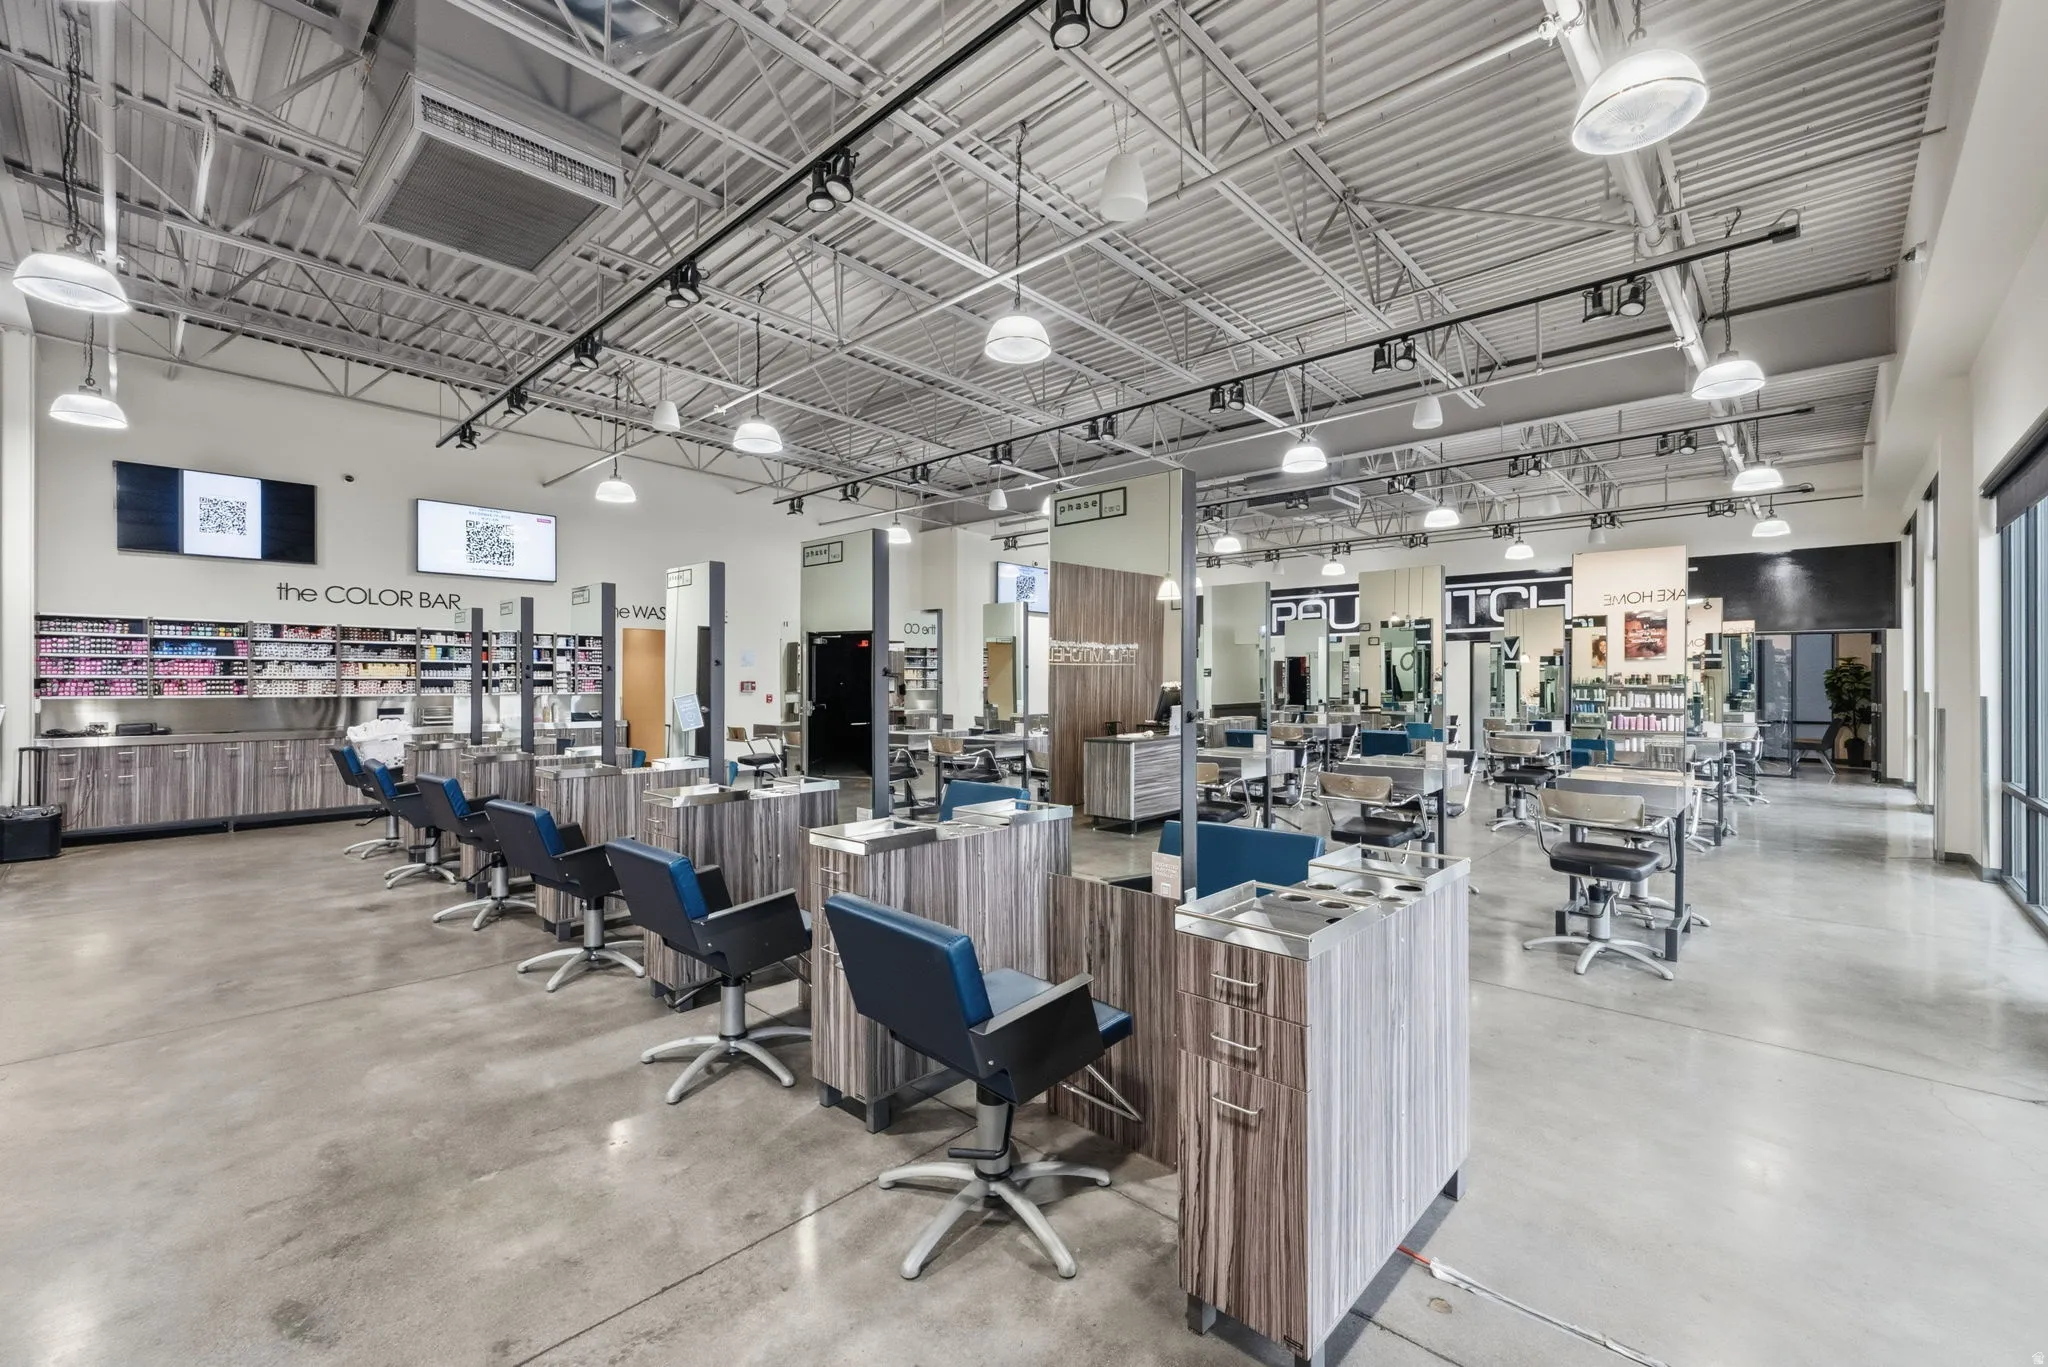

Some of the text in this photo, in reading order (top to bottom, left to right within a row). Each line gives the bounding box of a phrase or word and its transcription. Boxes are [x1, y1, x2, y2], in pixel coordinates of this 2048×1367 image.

[1059, 499, 1098, 515] phase
[276, 582, 461, 610] the COLOR BAR
[632, 605, 666, 621] WAS
[1272, 583, 1572, 633] PAU ITCH
